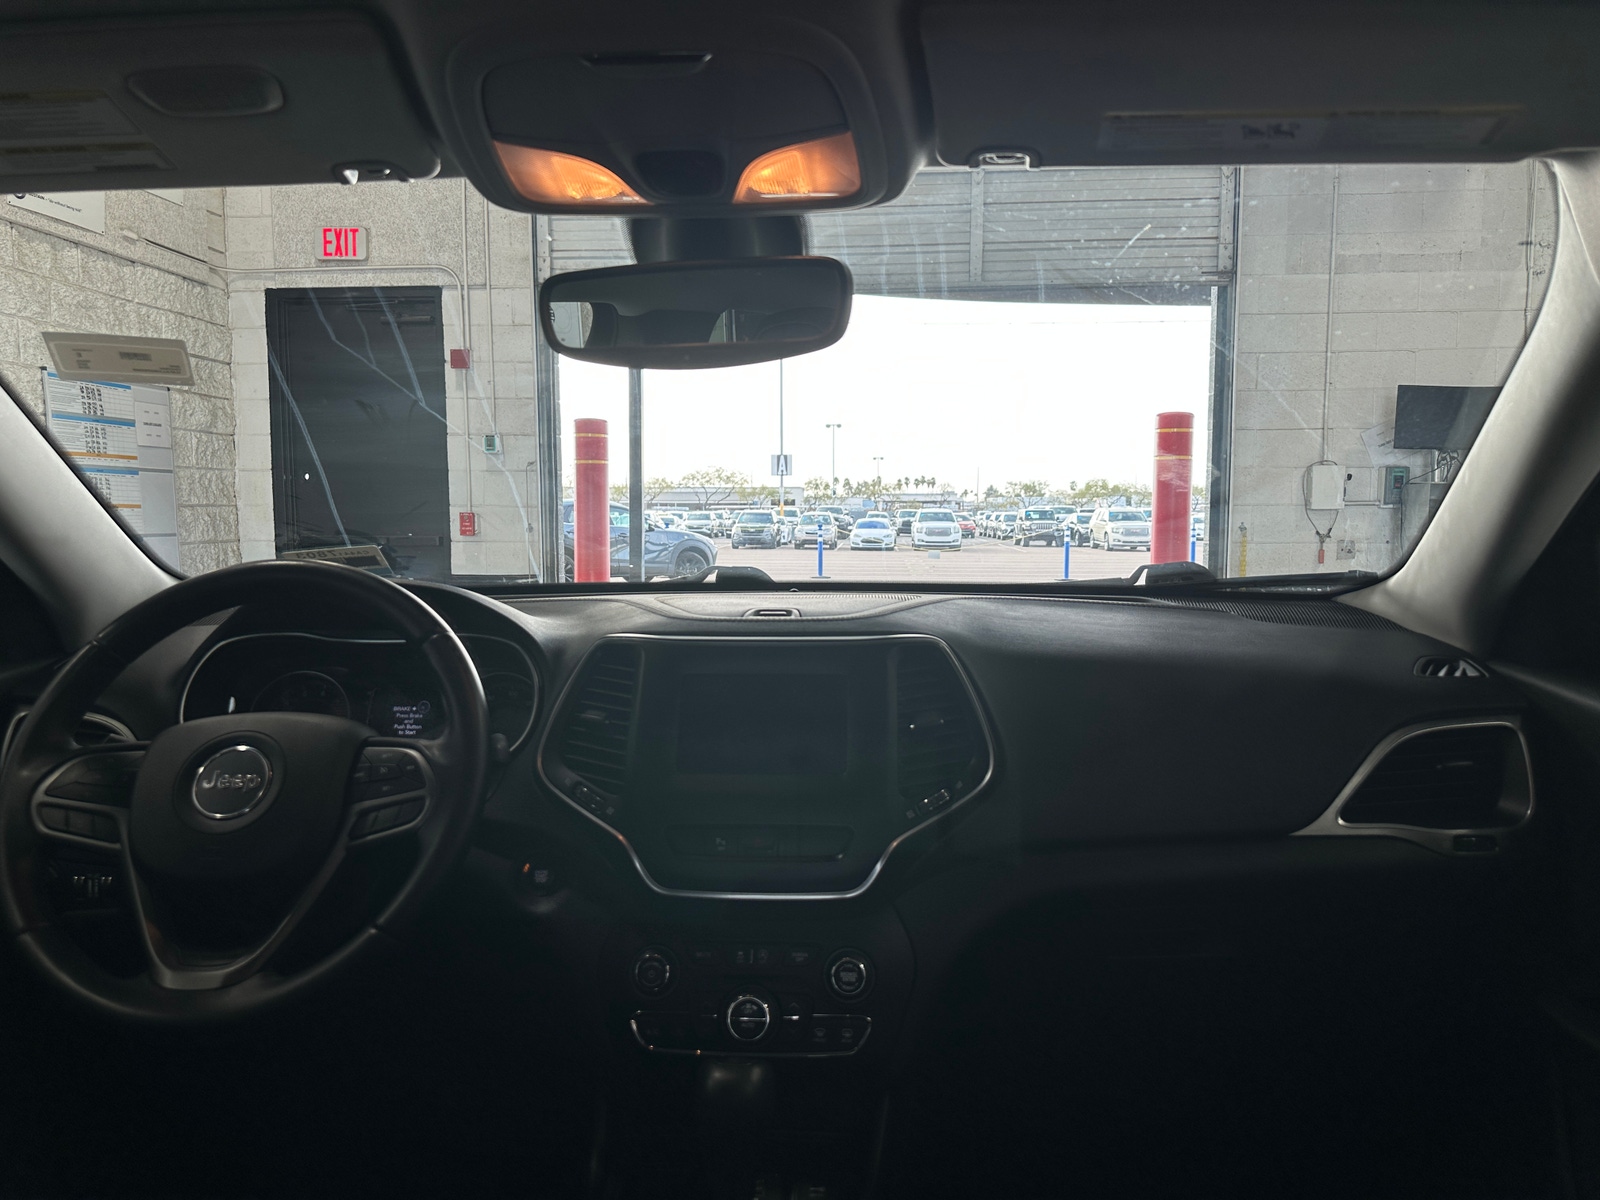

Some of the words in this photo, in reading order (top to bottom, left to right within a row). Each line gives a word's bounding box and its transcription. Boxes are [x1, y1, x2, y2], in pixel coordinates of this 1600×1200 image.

[323, 227, 360, 257] EXIT
[777, 455, 788, 475] A
[202, 770, 261, 791] Jeep
